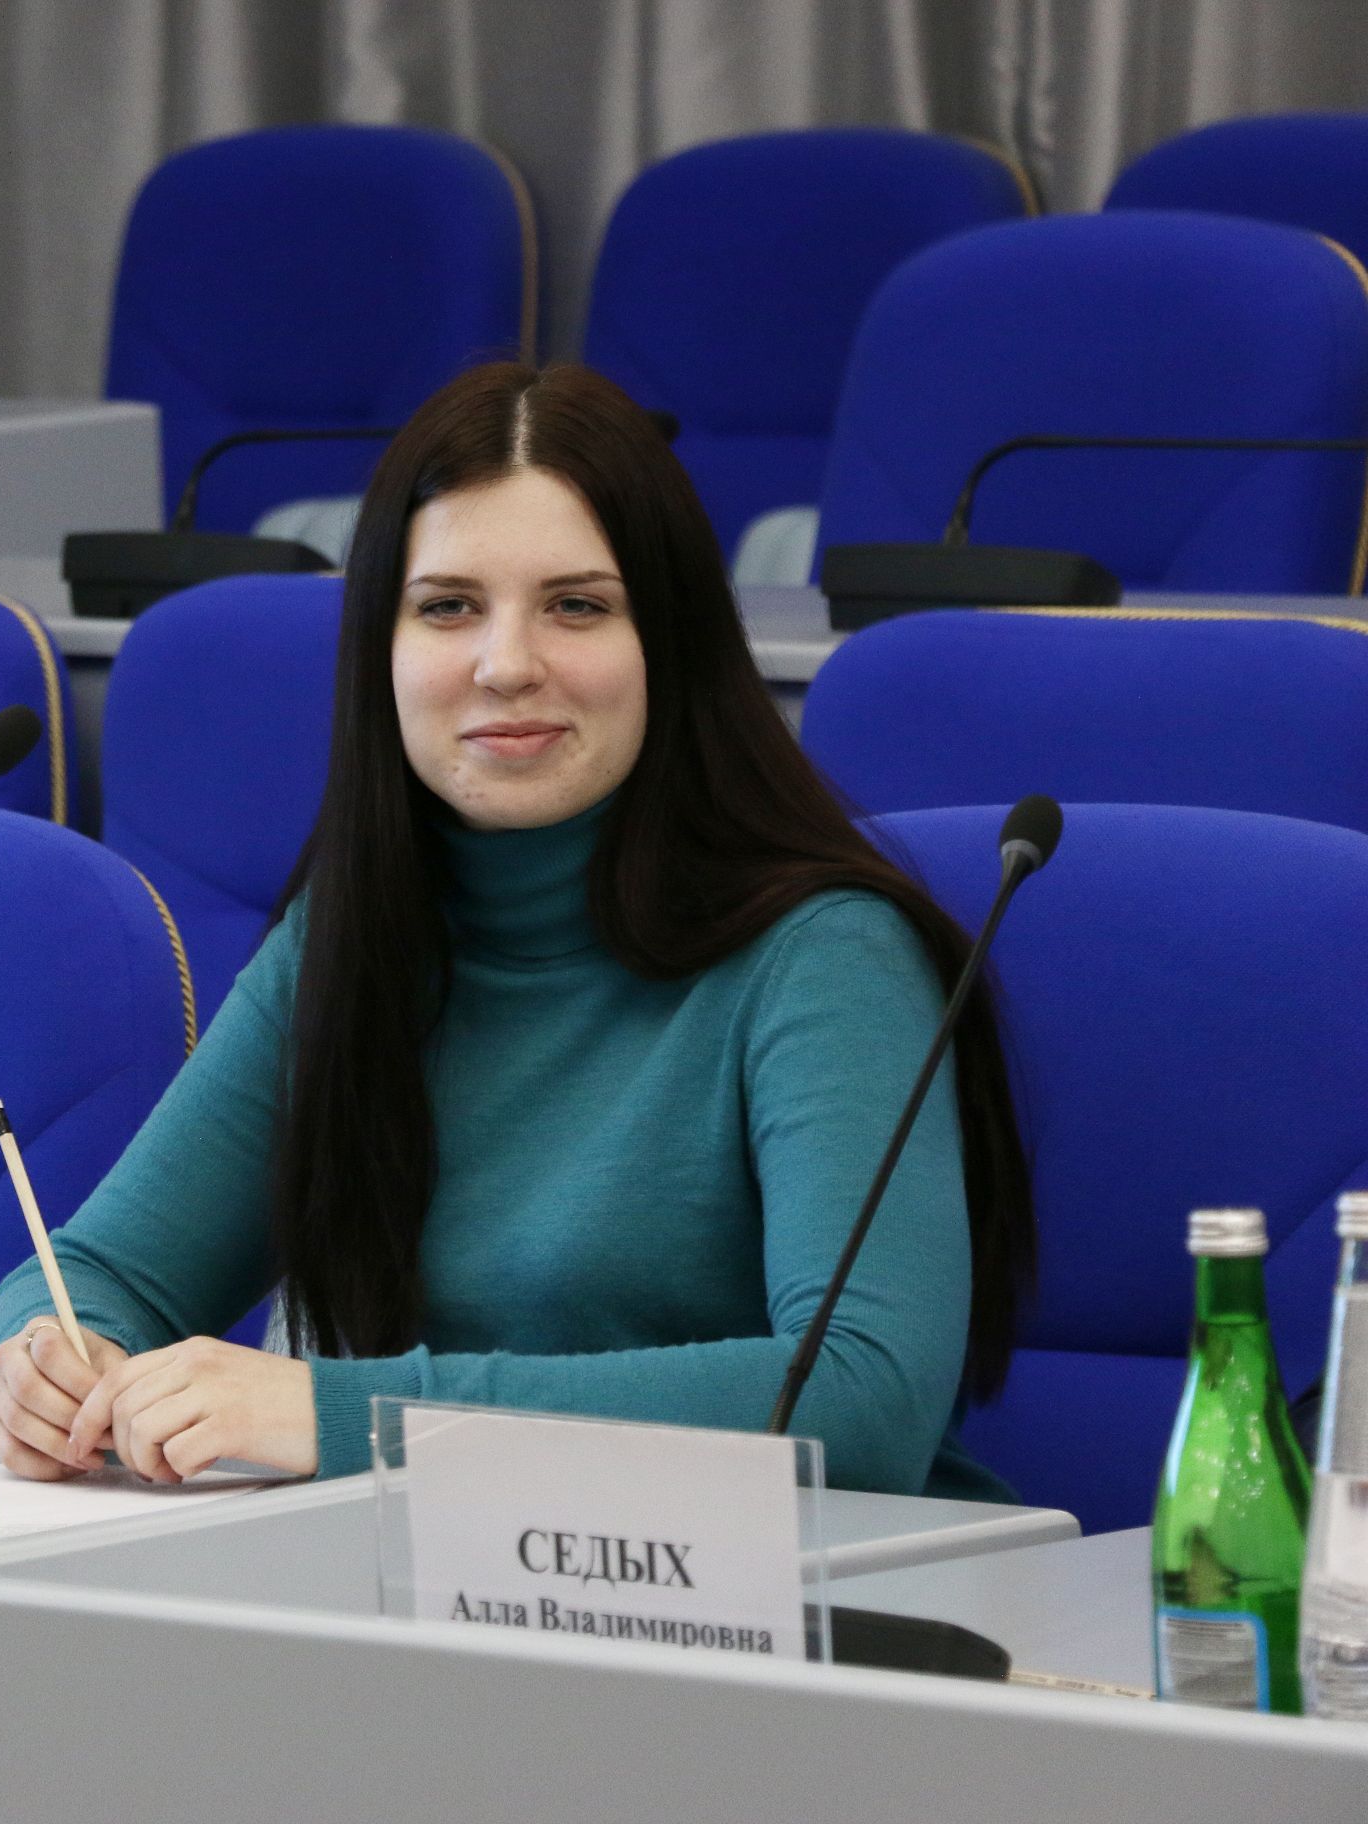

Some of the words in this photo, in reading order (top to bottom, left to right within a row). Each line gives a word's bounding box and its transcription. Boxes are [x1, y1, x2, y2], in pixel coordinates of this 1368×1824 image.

[516, 1527, 697, 1591] СЕДЫХ
[450, 1590, 529, 1628] Алла
[538, 1597, 775, 1655] Владимировна
